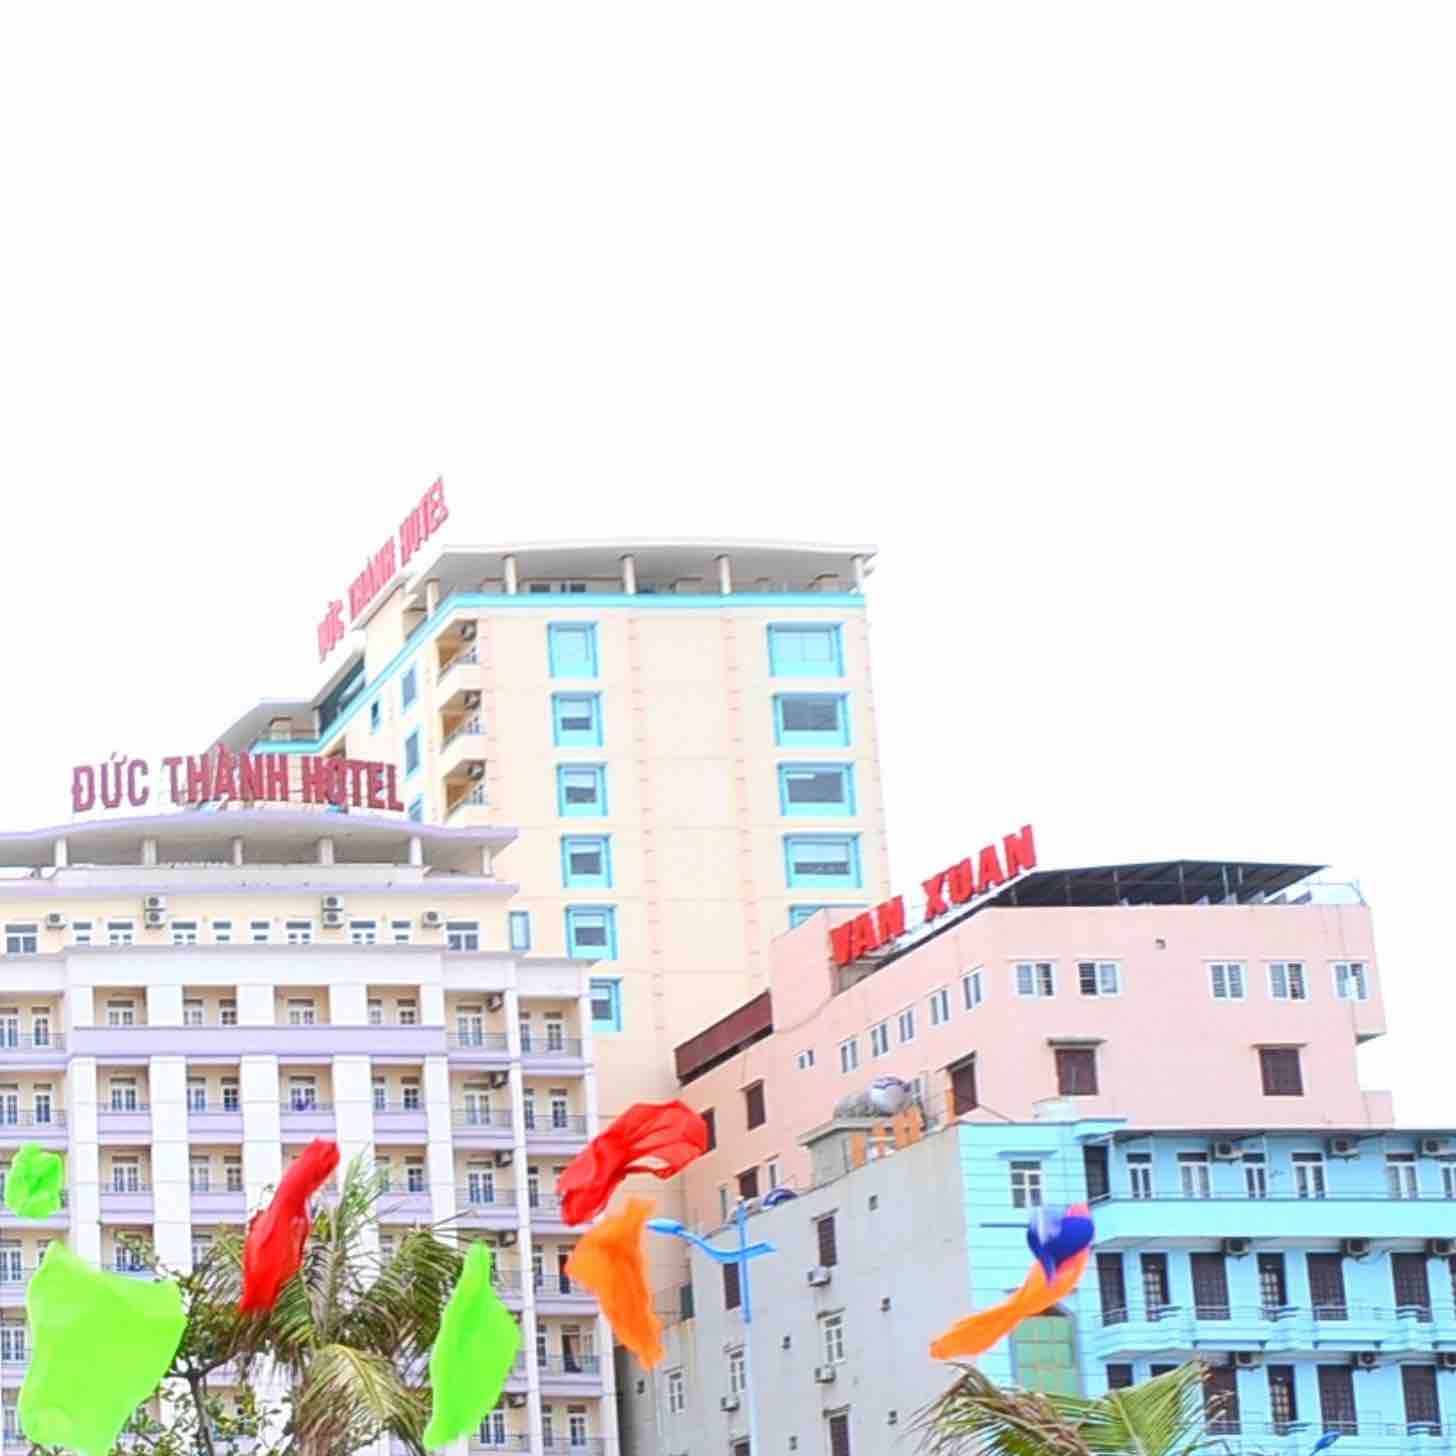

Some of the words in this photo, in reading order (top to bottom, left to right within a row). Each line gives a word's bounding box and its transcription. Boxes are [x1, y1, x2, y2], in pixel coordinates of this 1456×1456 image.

[71, 751, 150, 813] ĐỨC
[161, 744, 289, 804] THÀNH
[300, 755, 405, 813] HOTEL
